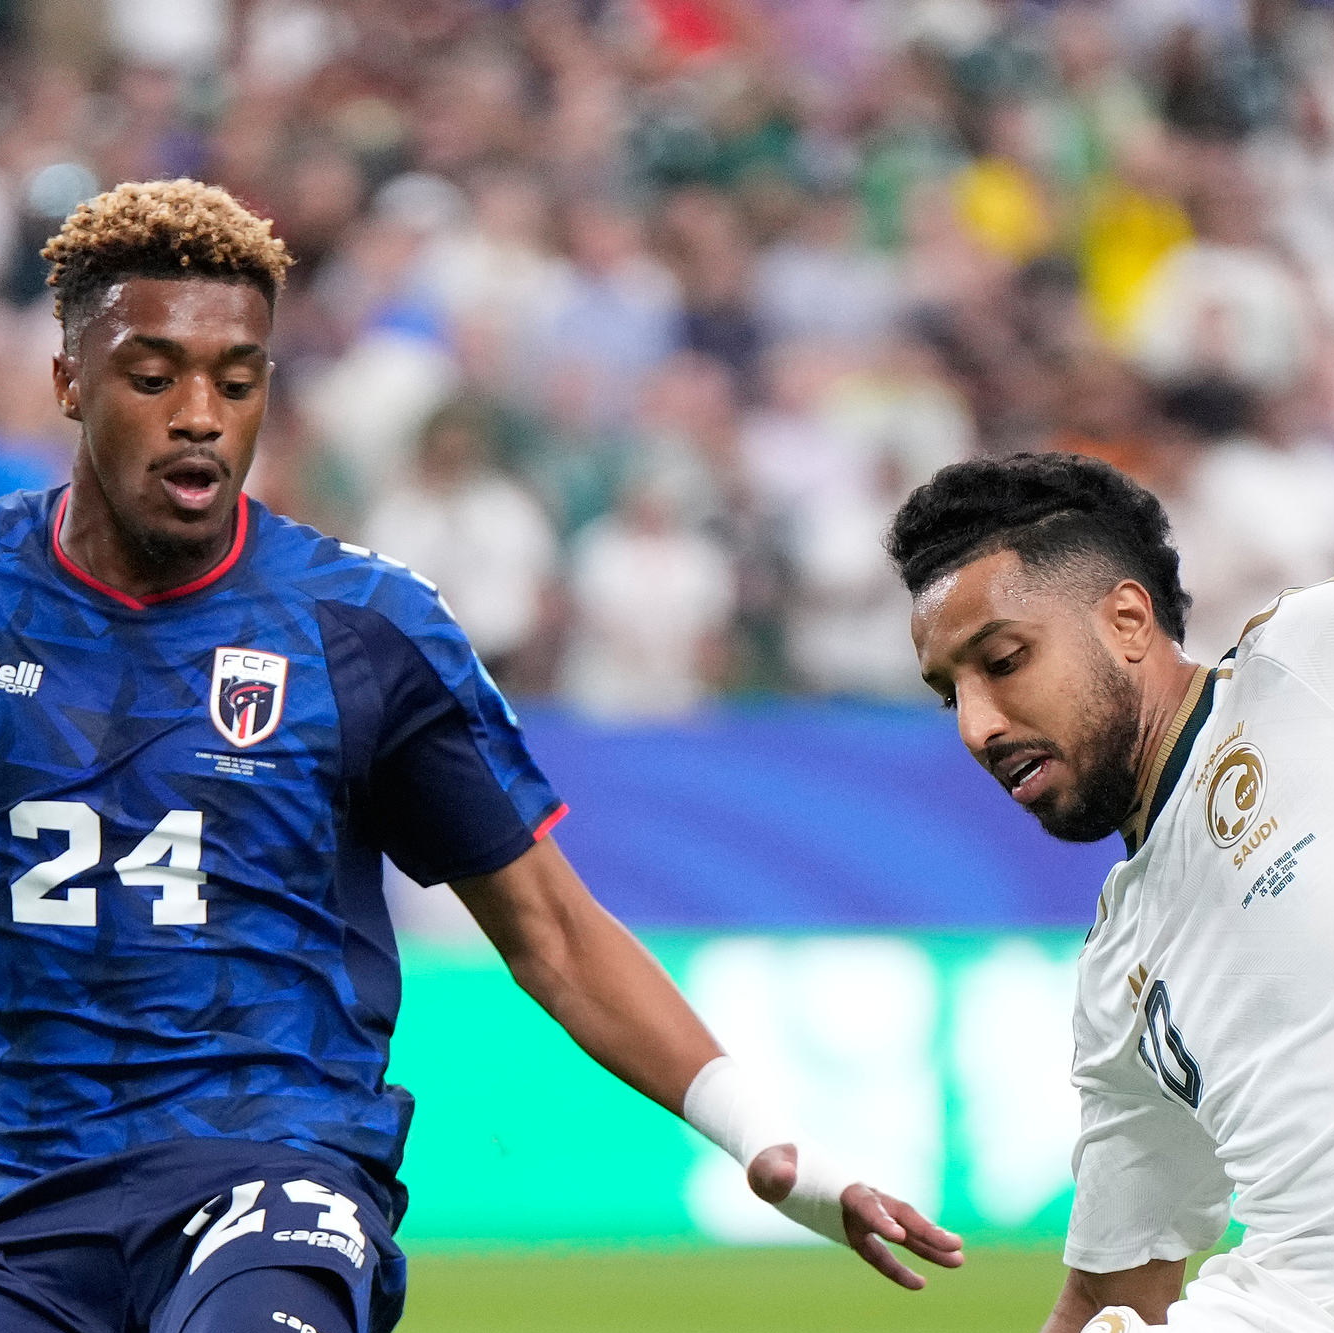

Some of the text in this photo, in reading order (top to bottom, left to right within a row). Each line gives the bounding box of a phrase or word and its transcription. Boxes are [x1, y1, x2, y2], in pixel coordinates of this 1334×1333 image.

[222, 654, 280, 672] FCF
[1236, 779, 1257, 806] SAFF
[8, 800, 208, 927] 24
[1233, 815, 1279, 872] SAUDI
[1250, 873, 1267, 895] VERDE
[1265, 865, 1275, 877] VS
[1273, 850, 1293, 869] SAUDI
[1291, 832, 1317, 854] ARABIA
[1259, 857, 1299, 898] 26 JUNE 2026
[1270, 871, 1296, 898] HOUSTON
